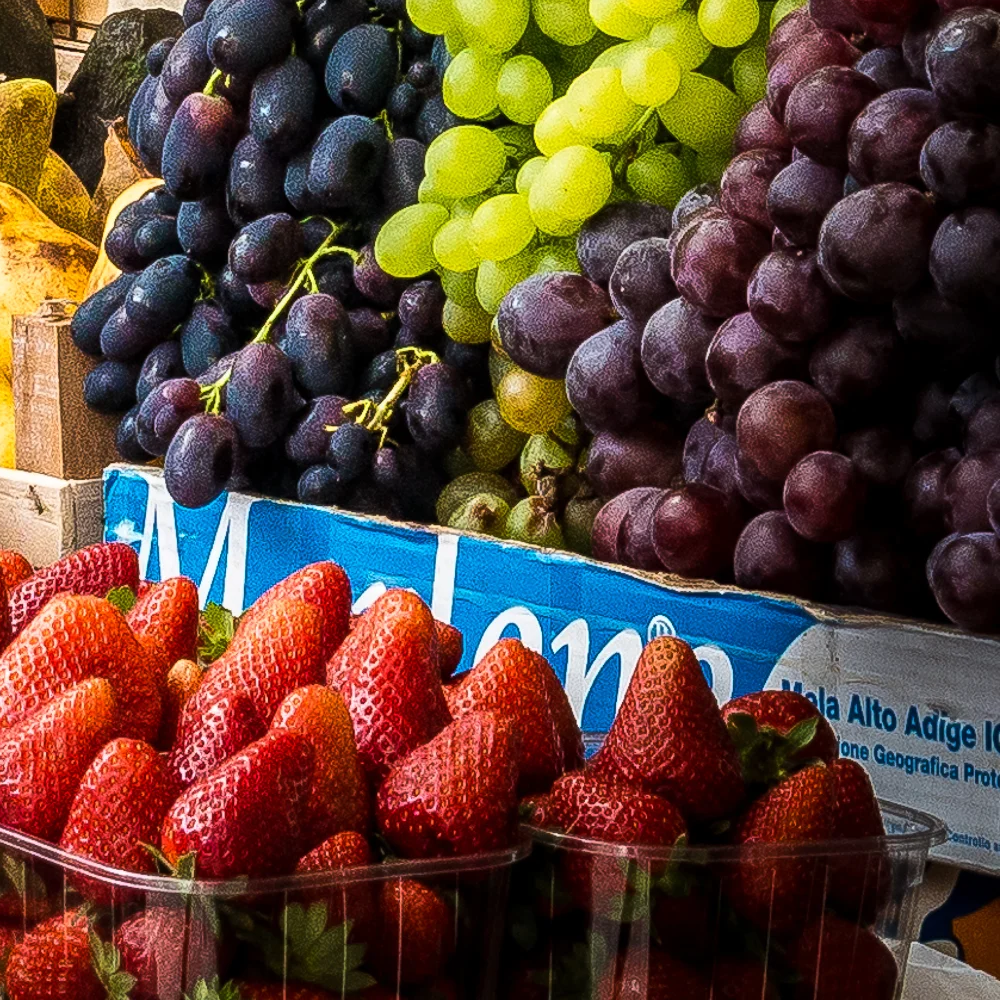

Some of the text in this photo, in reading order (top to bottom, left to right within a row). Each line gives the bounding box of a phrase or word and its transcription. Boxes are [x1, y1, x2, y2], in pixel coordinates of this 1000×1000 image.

[847, 693, 897, 732] Alto
[904, 704, 977, 752] Adige
[873, 743, 960, 782] Geografica
